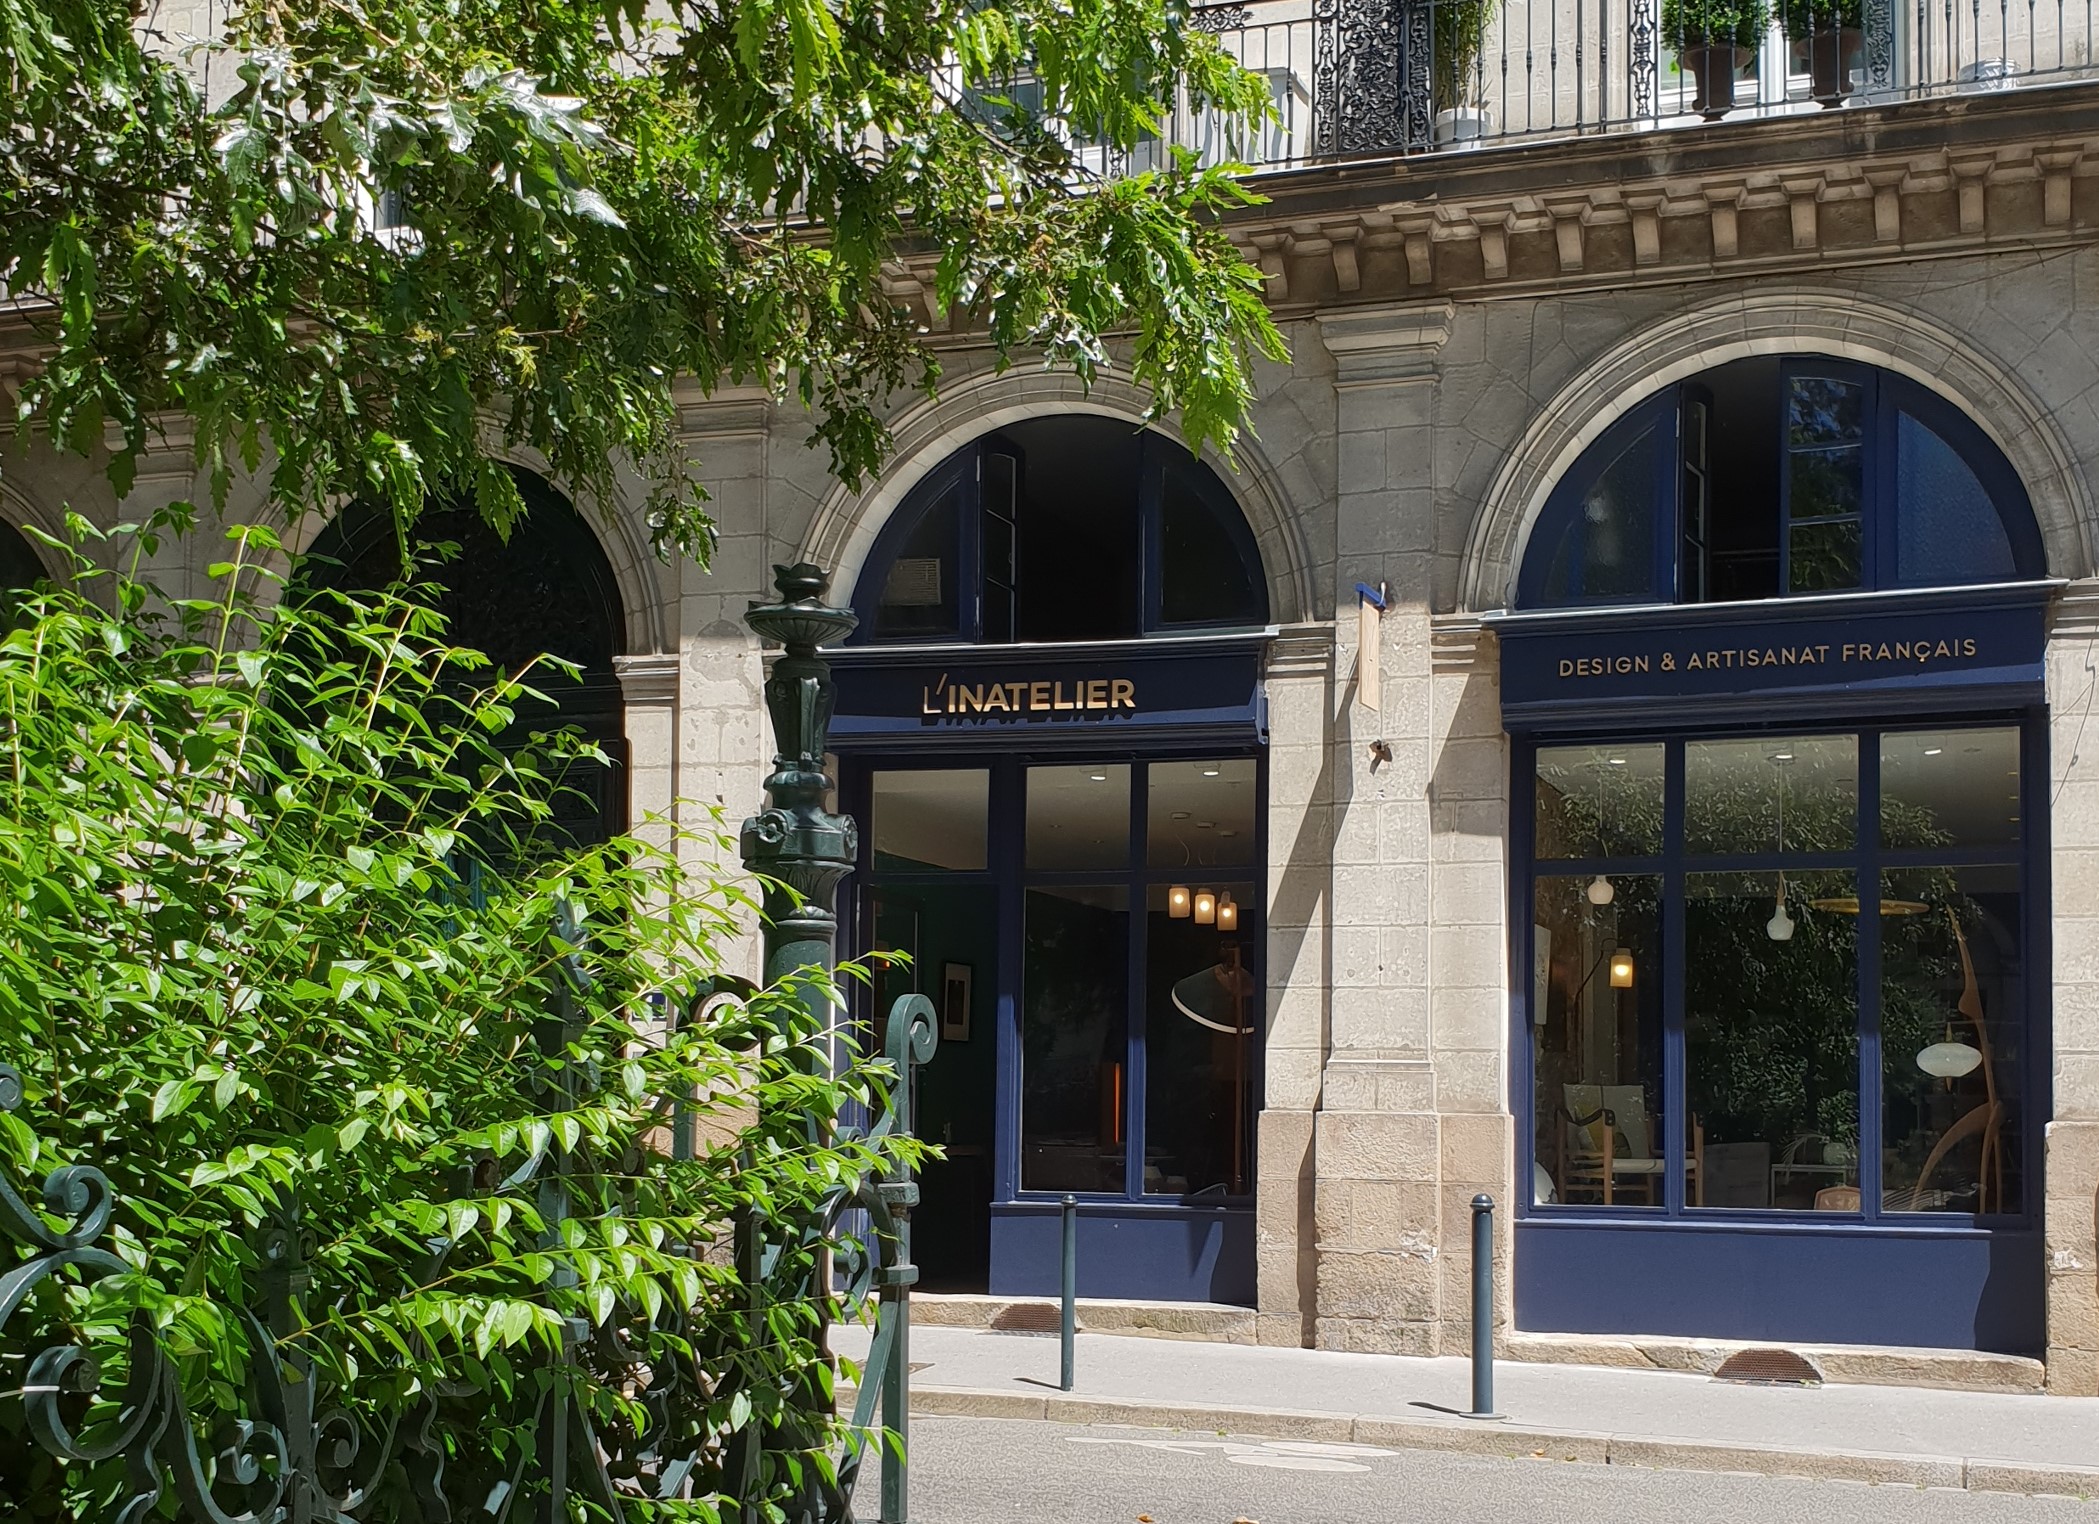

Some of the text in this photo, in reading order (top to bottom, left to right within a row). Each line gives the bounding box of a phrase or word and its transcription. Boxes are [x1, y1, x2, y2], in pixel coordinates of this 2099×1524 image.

[1559, 638, 1977, 677] DESIGN & ARTISANAT FRANÇAIS
[923, 673, 1136, 714] L'INATELIER
